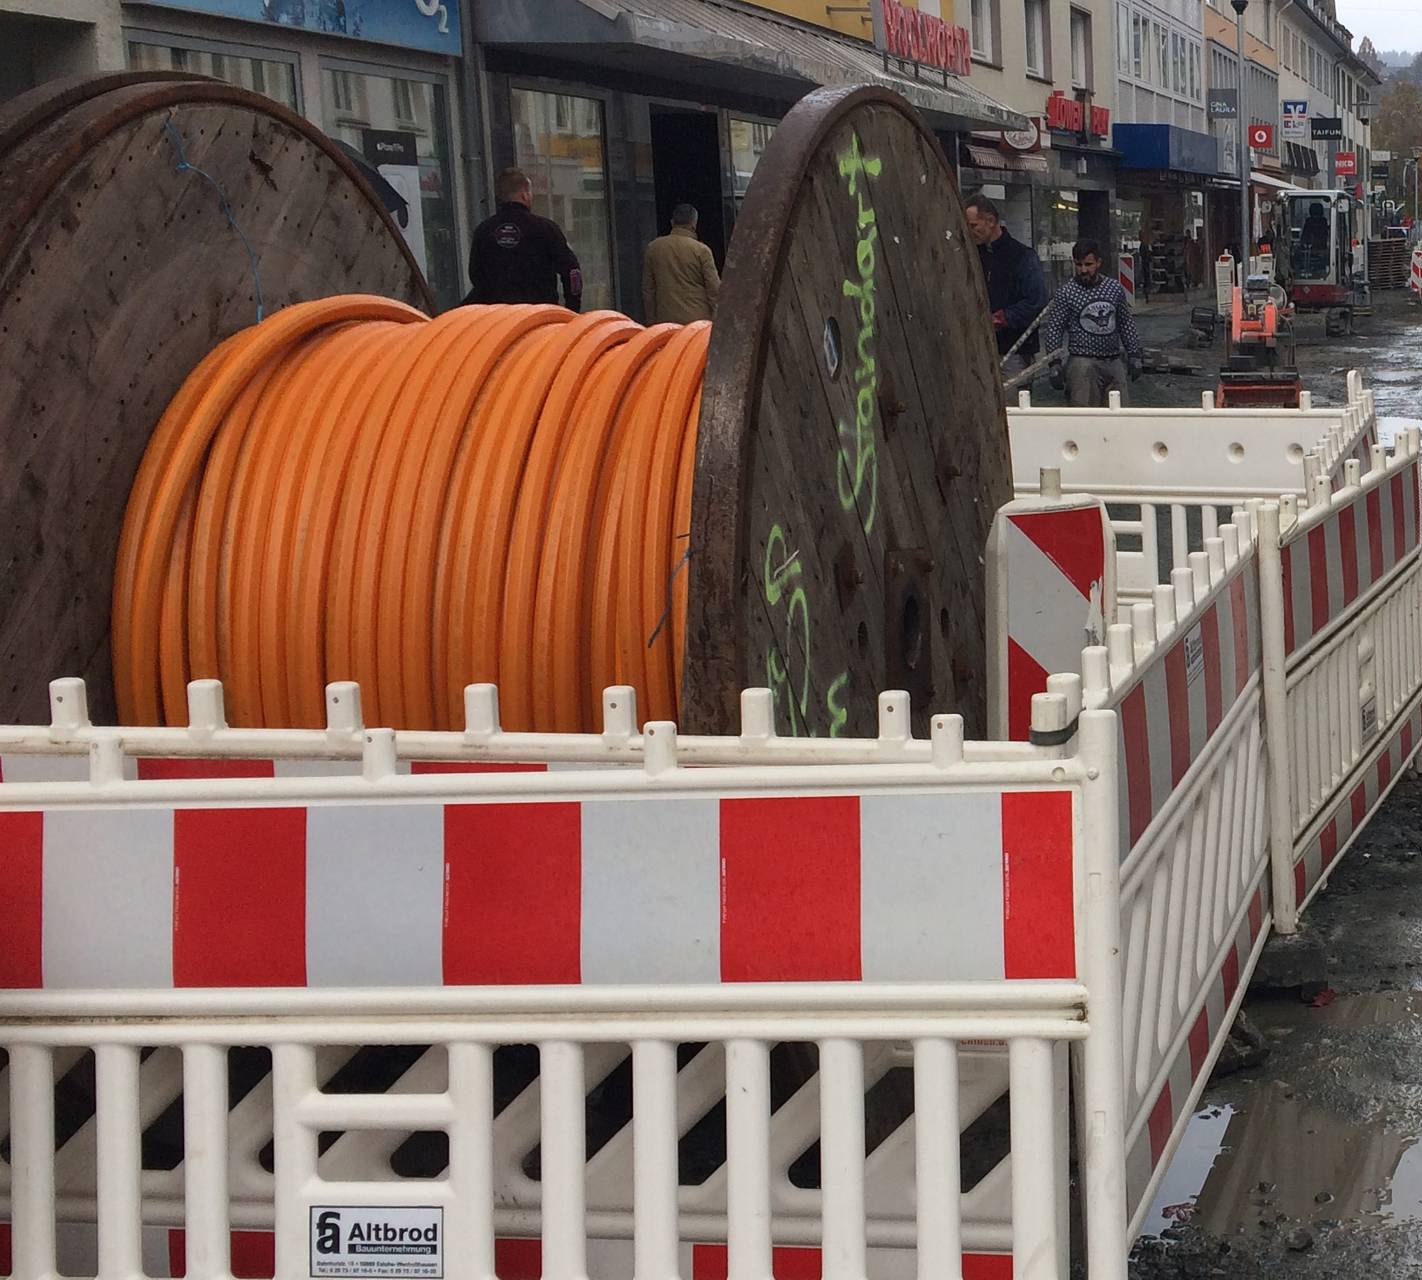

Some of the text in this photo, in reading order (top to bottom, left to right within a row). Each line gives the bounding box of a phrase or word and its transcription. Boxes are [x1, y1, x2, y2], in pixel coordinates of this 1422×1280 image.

[1335, 160, 1354, 168] NKD
[348, 1223, 437, 1242] Altbrod
[355, 1244, 431, 1254] Bauunternehmung
